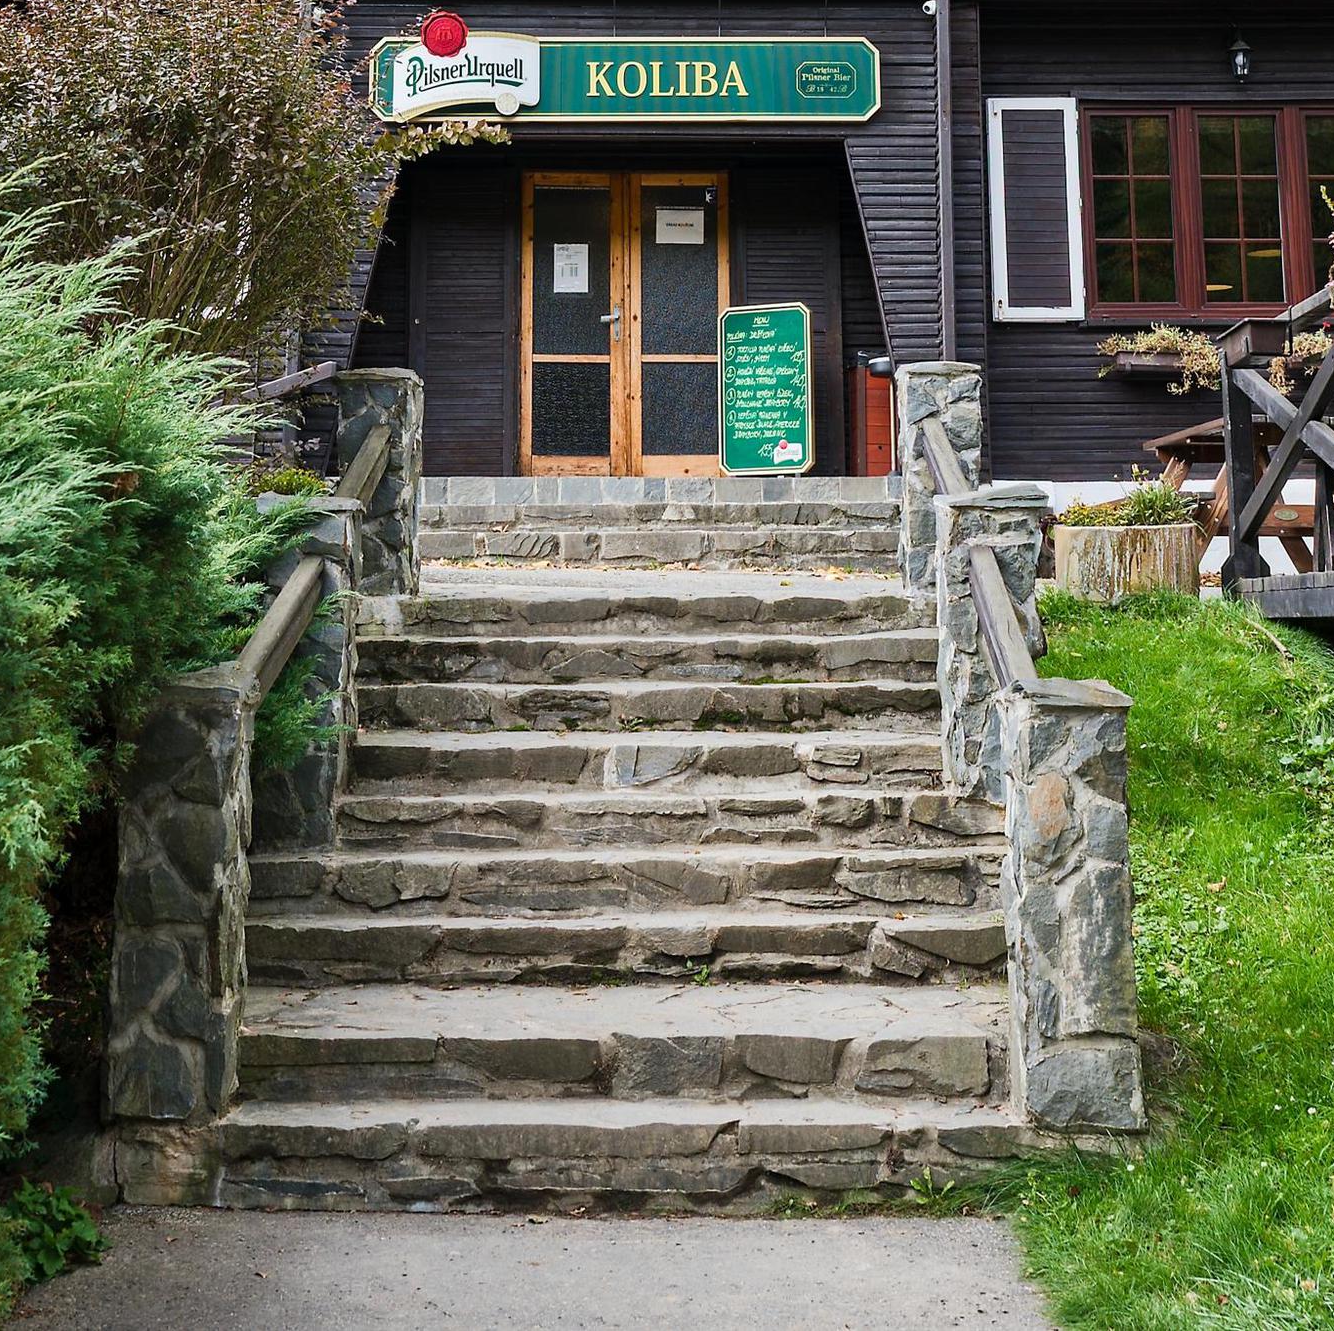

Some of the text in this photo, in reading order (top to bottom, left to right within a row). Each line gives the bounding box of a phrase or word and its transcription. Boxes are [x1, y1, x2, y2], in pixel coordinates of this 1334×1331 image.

[406, 53, 523, 97] Pilsner Urquell
[586, 61, 749, 97] KOLIBA
[802, 73, 851, 81] Pilsner Bier
[812, 66, 840, 74] Original
